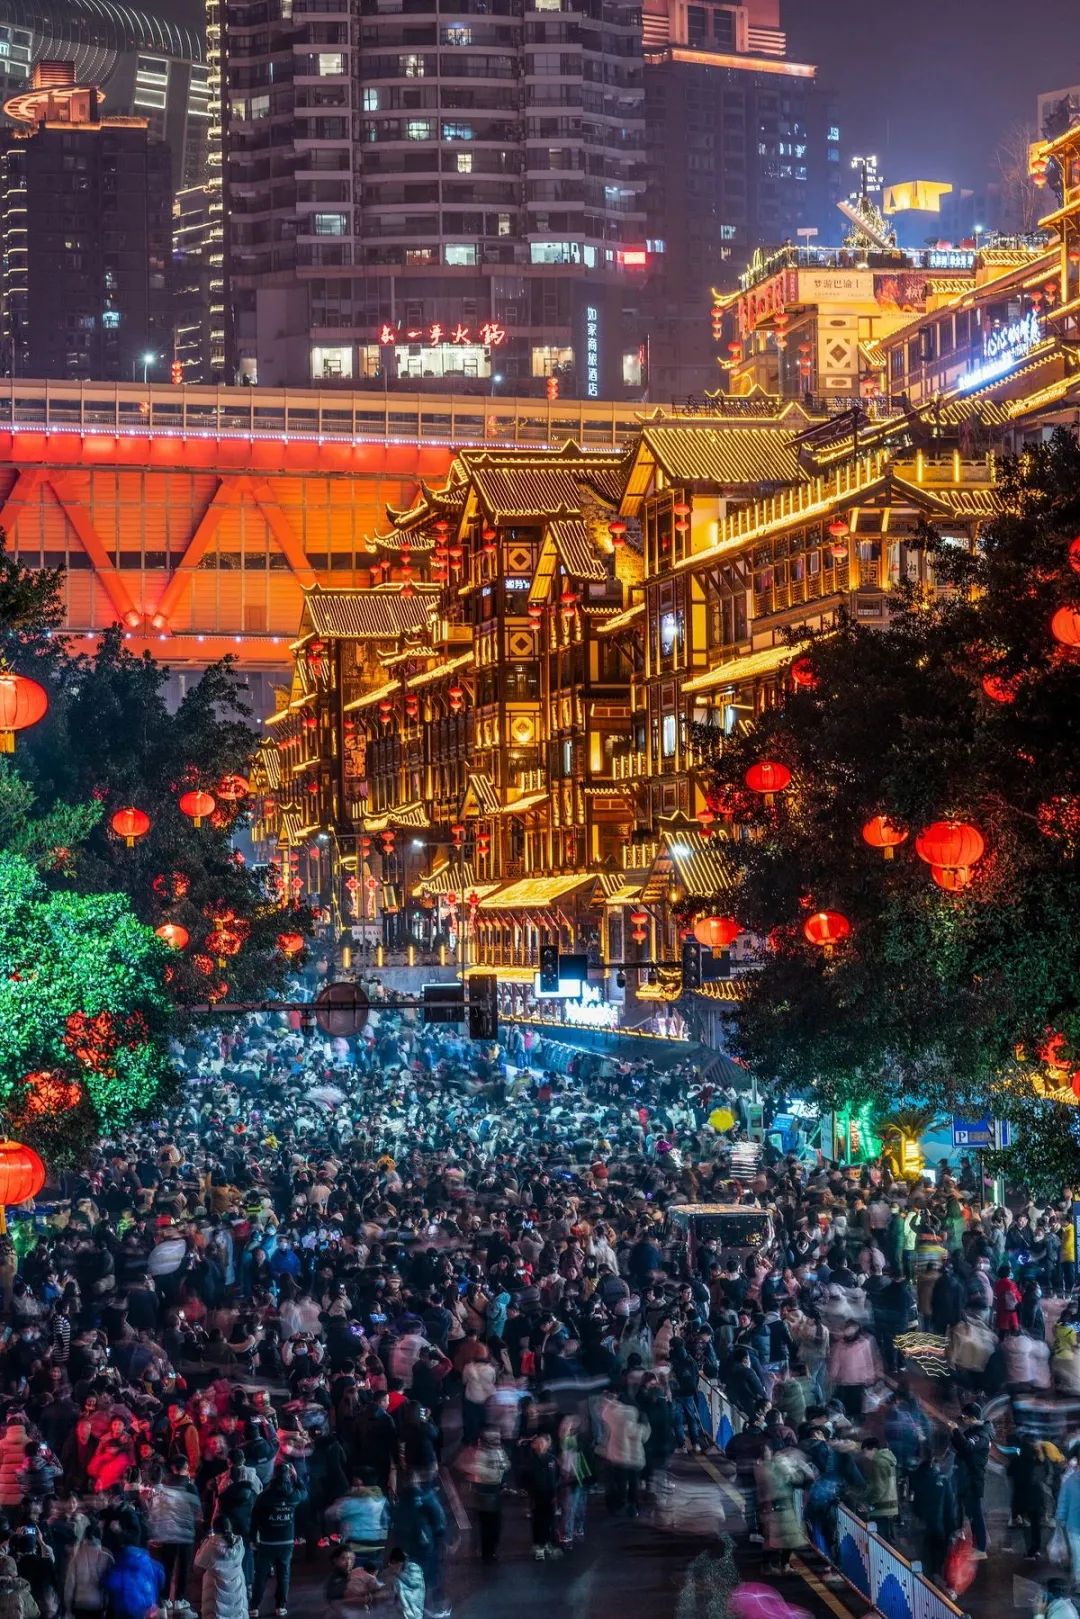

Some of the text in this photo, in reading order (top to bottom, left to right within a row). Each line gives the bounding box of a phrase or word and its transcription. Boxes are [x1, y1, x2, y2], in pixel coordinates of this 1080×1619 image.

[587, 307, 598, 397] 如家商旅酒店
[957, 1131, 967, 1143] P
